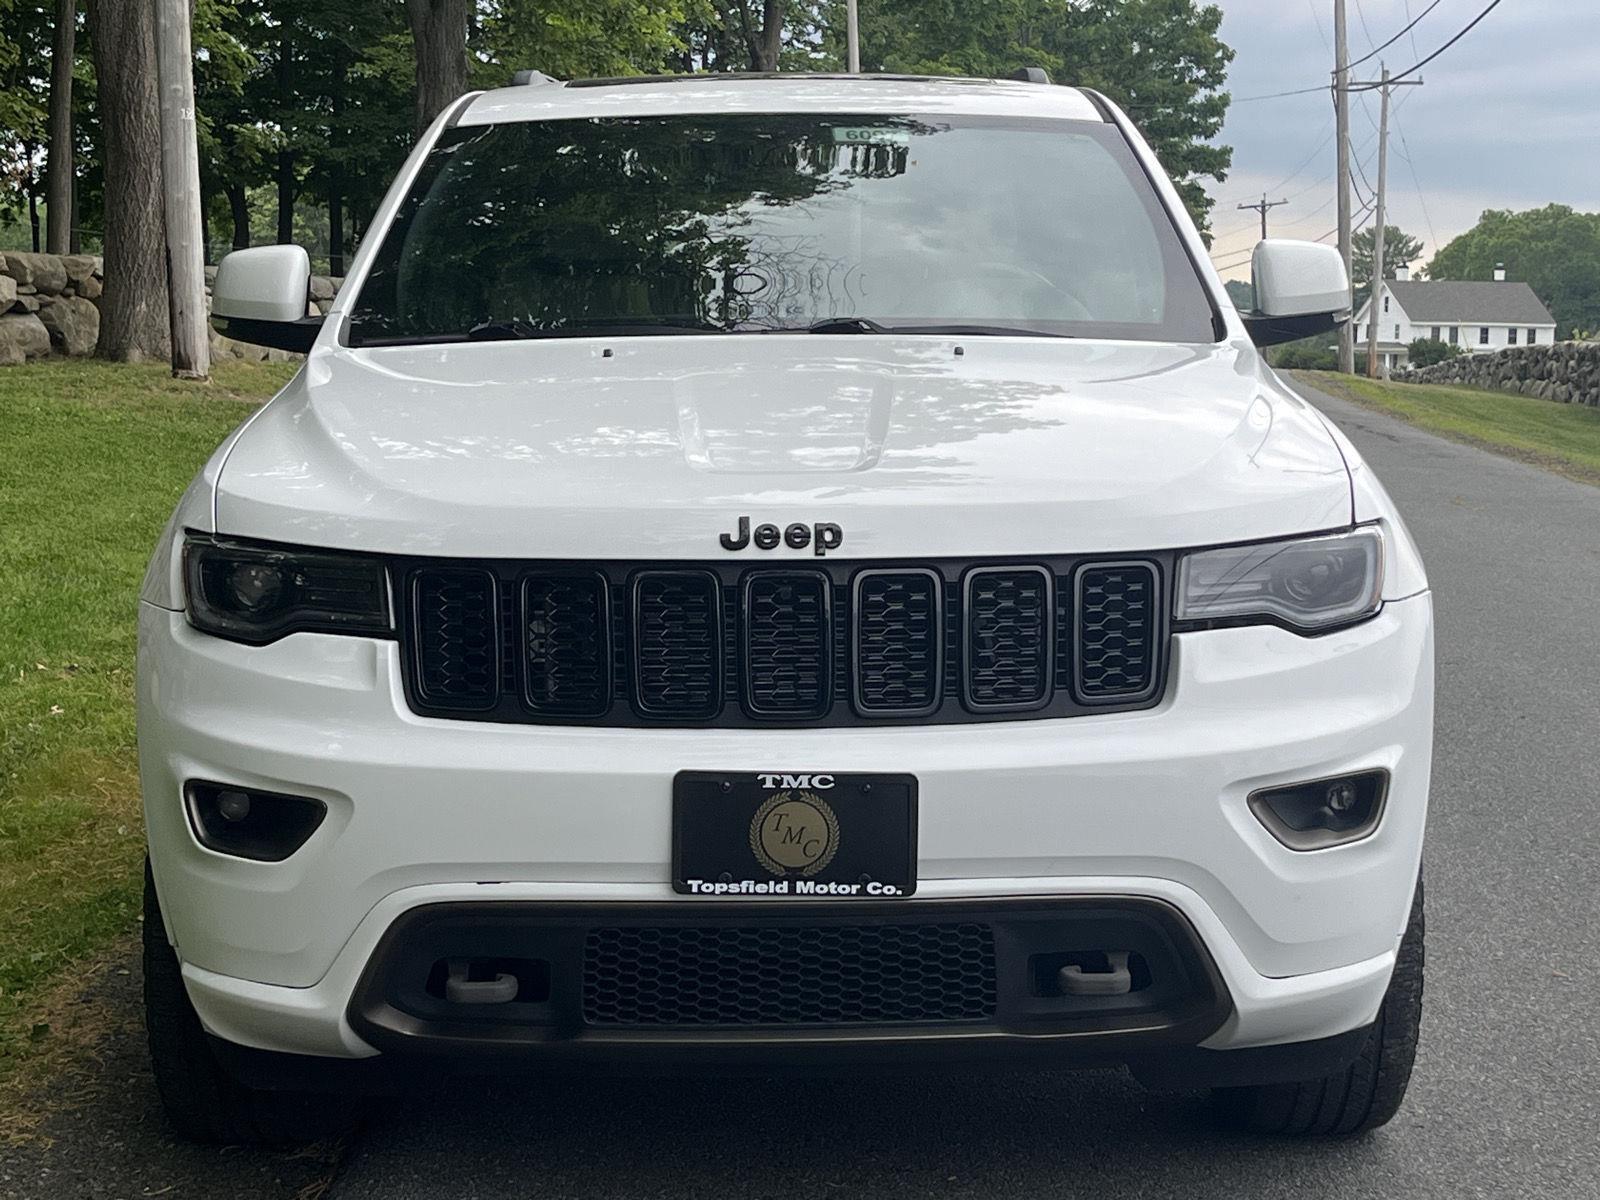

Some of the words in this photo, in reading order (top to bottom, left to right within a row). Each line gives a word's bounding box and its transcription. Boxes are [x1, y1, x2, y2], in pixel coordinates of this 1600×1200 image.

[719, 516, 843, 556] Jeep
[757, 774, 835, 789] TMC
[687, 880, 789, 894] Topsfield
[796, 881, 861, 895] Motor
[866, 882, 903, 895] Co.
